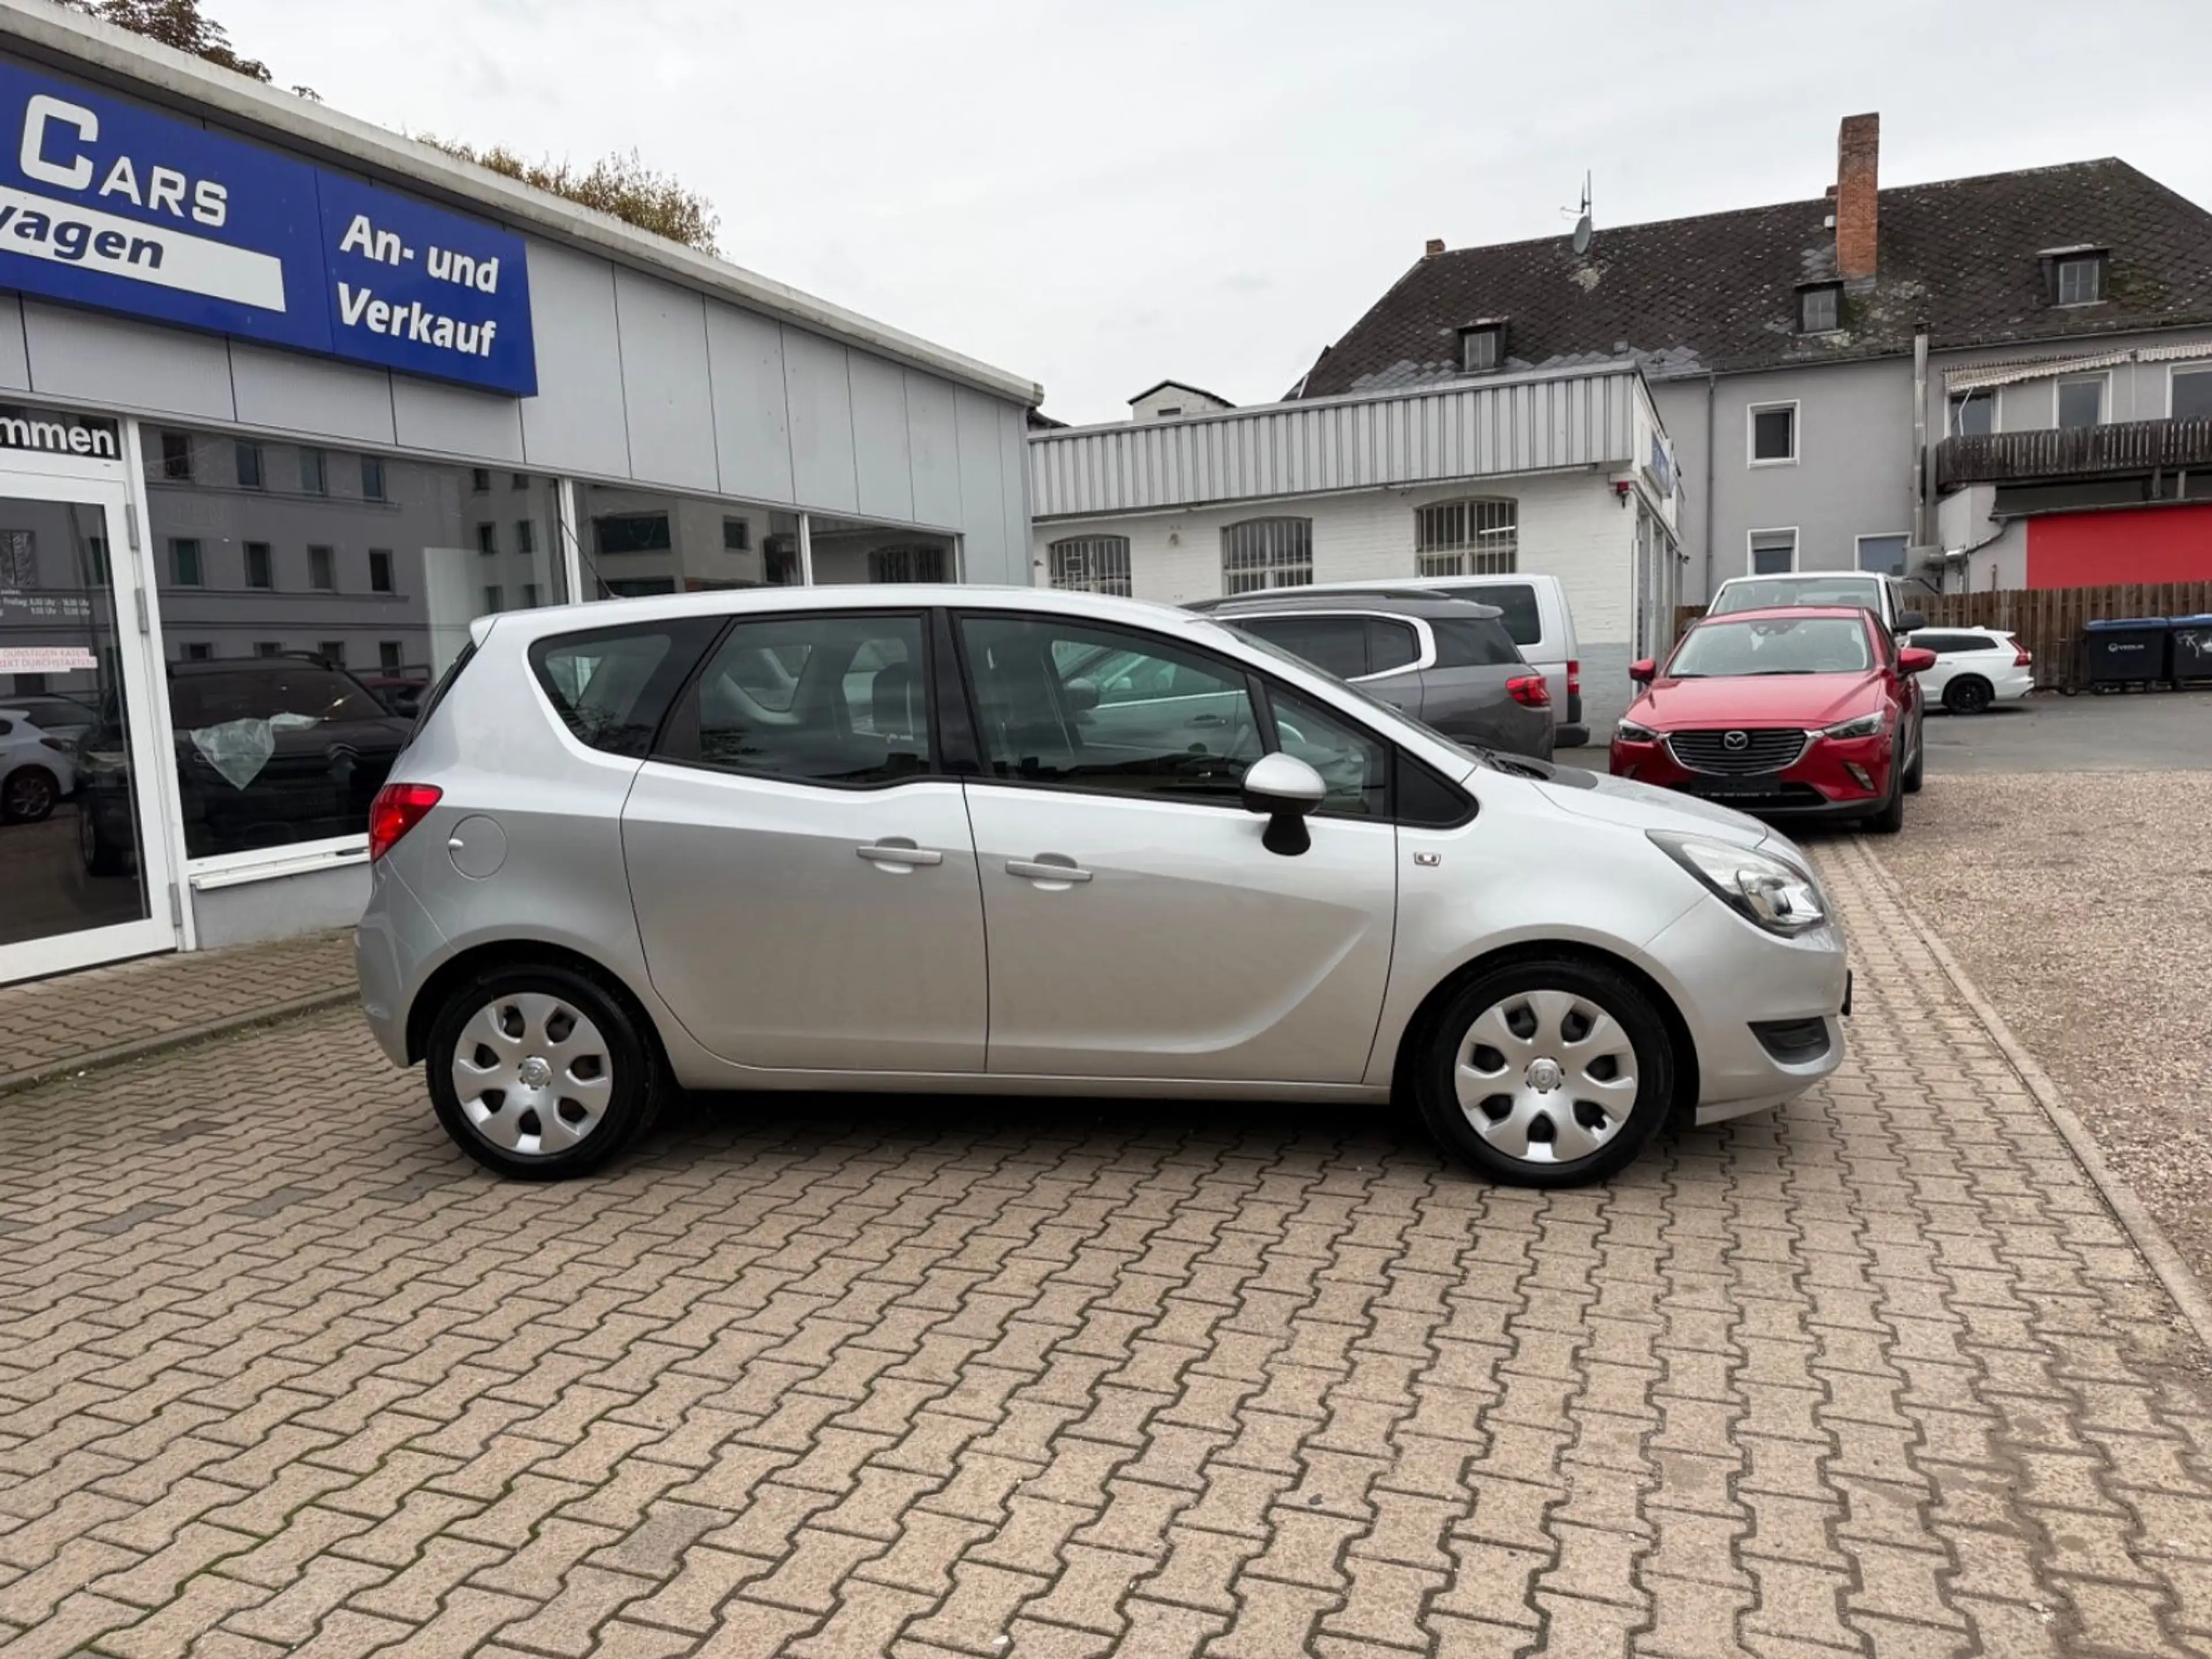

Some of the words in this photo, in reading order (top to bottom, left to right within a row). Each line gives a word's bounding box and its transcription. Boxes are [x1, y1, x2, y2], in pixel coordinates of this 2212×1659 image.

[20, 94, 228, 228] CARS
[339, 214, 414, 266] An-
[427, 245, 499, 294] und
[338, 281, 497, 358] Verkauf
